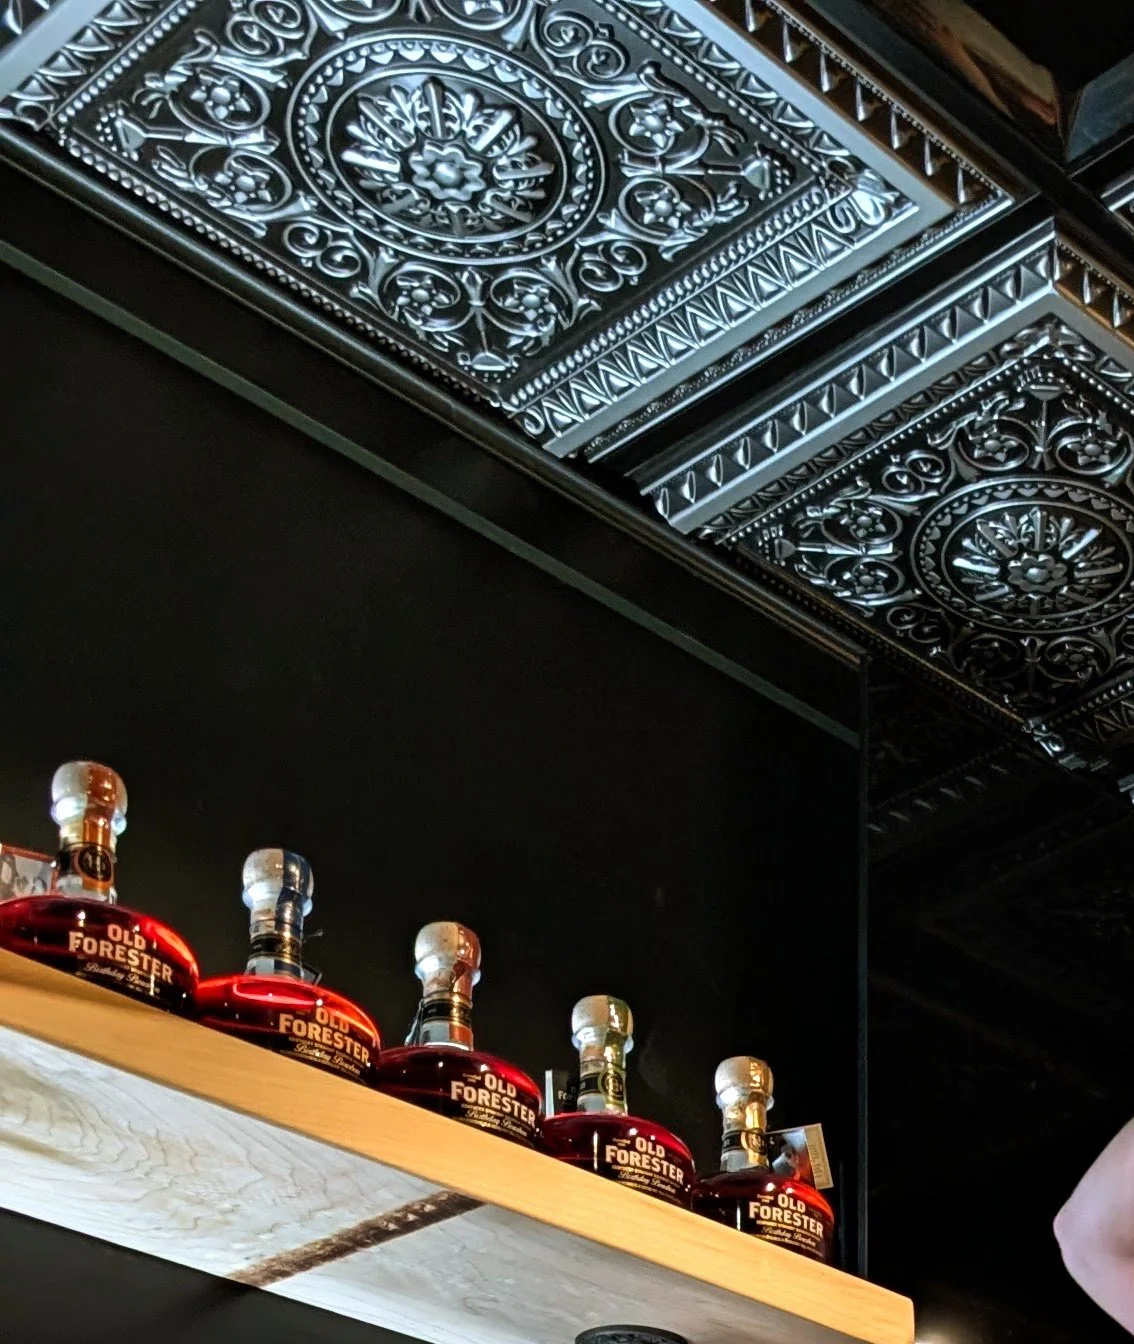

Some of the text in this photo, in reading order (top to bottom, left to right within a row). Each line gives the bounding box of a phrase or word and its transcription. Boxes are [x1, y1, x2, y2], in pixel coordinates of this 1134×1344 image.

[107, 923, 147, 951] OLD
[68, 931, 173, 984] FORESTER
[315, 1007, 350, 1034] OLD
[278, 1013, 370, 1063] FORESTER
[484, 1072, 517, 1099] OLD
[450, 1080, 536, 1128] FORESTER
[635, 1136, 666, 1159] OLD
[605, 1144, 685, 1186] FORESTER
[748, 1201, 824, 1238] FORESTER
[777, 1193, 806, 1214] OLD
